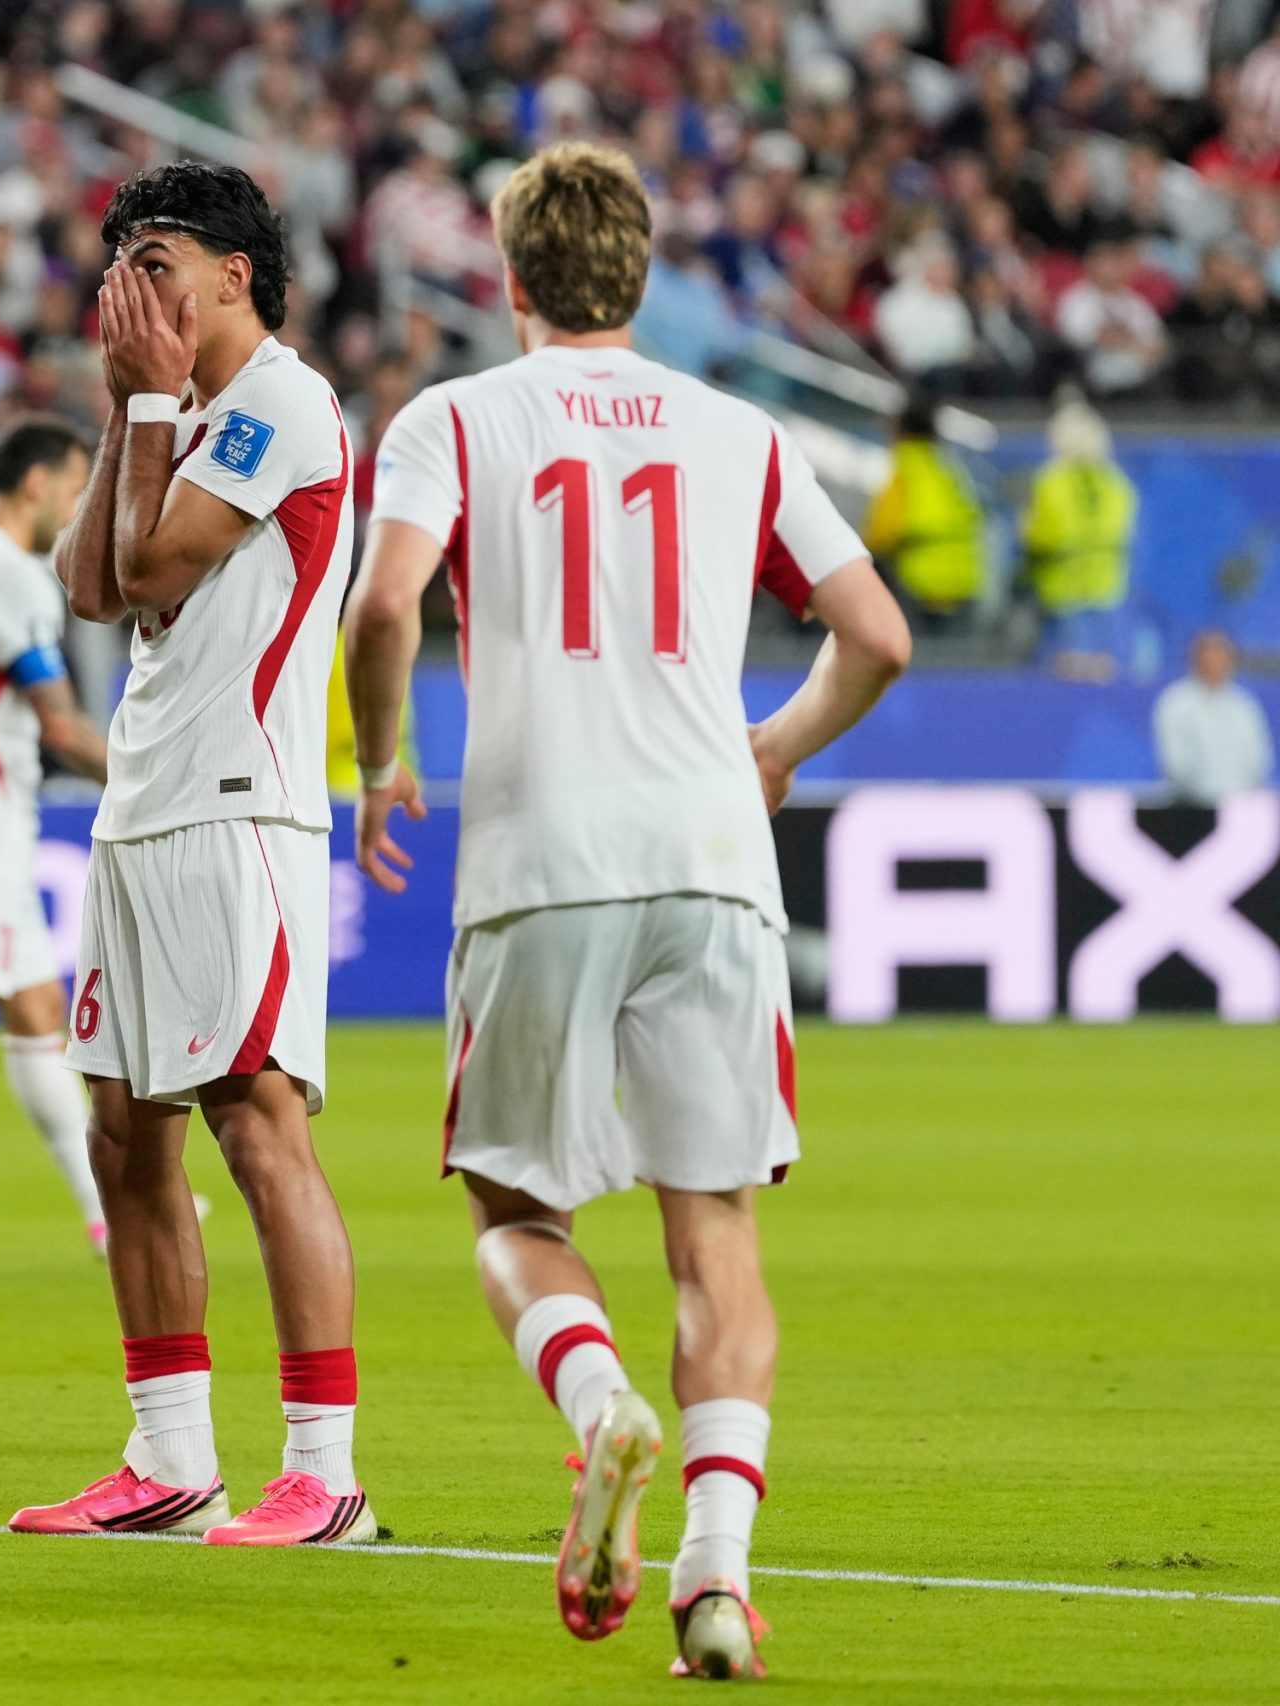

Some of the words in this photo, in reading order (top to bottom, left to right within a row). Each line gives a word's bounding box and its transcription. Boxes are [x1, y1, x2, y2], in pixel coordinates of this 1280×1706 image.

[556, 388, 668, 428] YILDIZ
[224, 444, 248, 463] PEACE
[533, 458, 687, 664] 11
